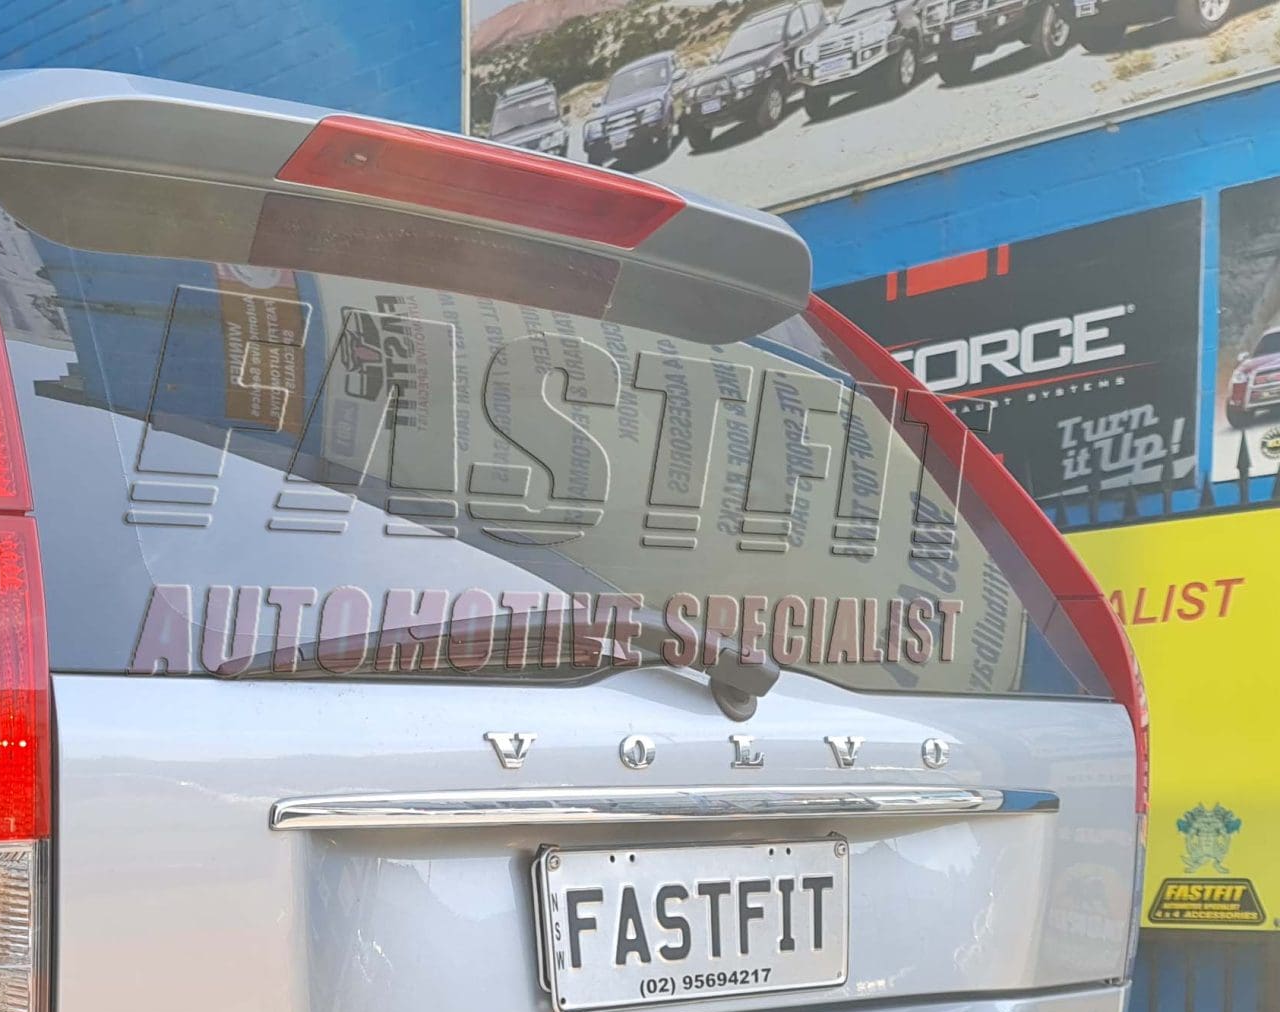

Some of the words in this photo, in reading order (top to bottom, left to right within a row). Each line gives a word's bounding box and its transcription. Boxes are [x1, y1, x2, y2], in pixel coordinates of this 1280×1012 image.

[1027, 376, 1126, 402] SYSTEMS
[1057, 403, 1160, 450] Turn
[1062, 447, 1092, 480] it
[1093, 417, 1186, 475] Up!
[484, 732, 950, 770] VOLVO
[1164, 884, 1248, 902] FASTFIT
[565, 875, 834, 968] FASTFIT
[1183, 911, 1259, 921] ACCESSORIES
[639, 976, 677, 998] (02)
[681, 967, 772, 991] 95694217
